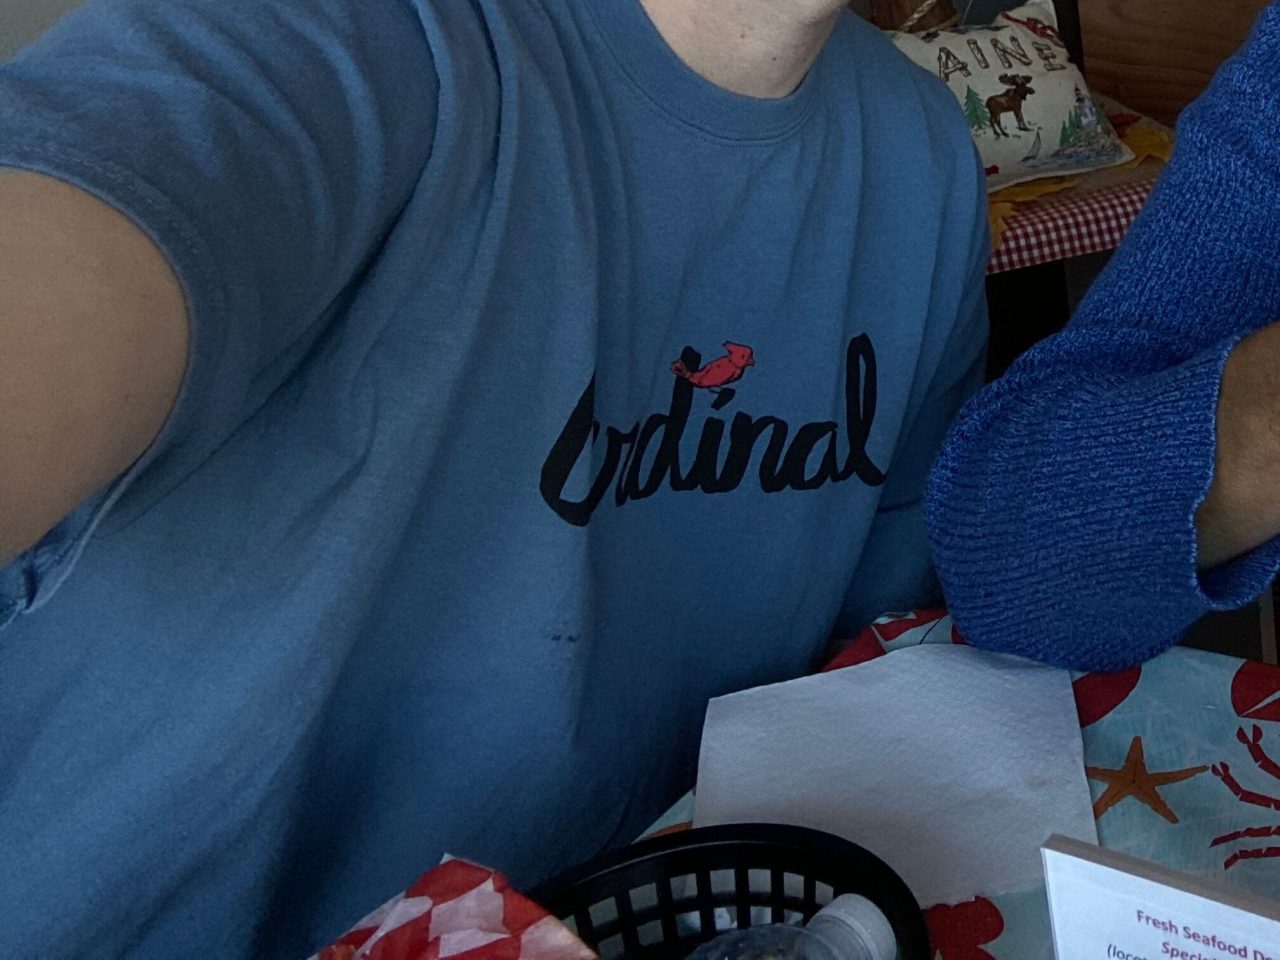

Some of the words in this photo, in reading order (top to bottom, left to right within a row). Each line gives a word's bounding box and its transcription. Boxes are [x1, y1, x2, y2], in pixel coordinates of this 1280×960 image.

[938, 36, 1066, 82] AINE
[1136, 909, 1178, 935] Fresh
[1183, 925, 1248, 958] Seafood
